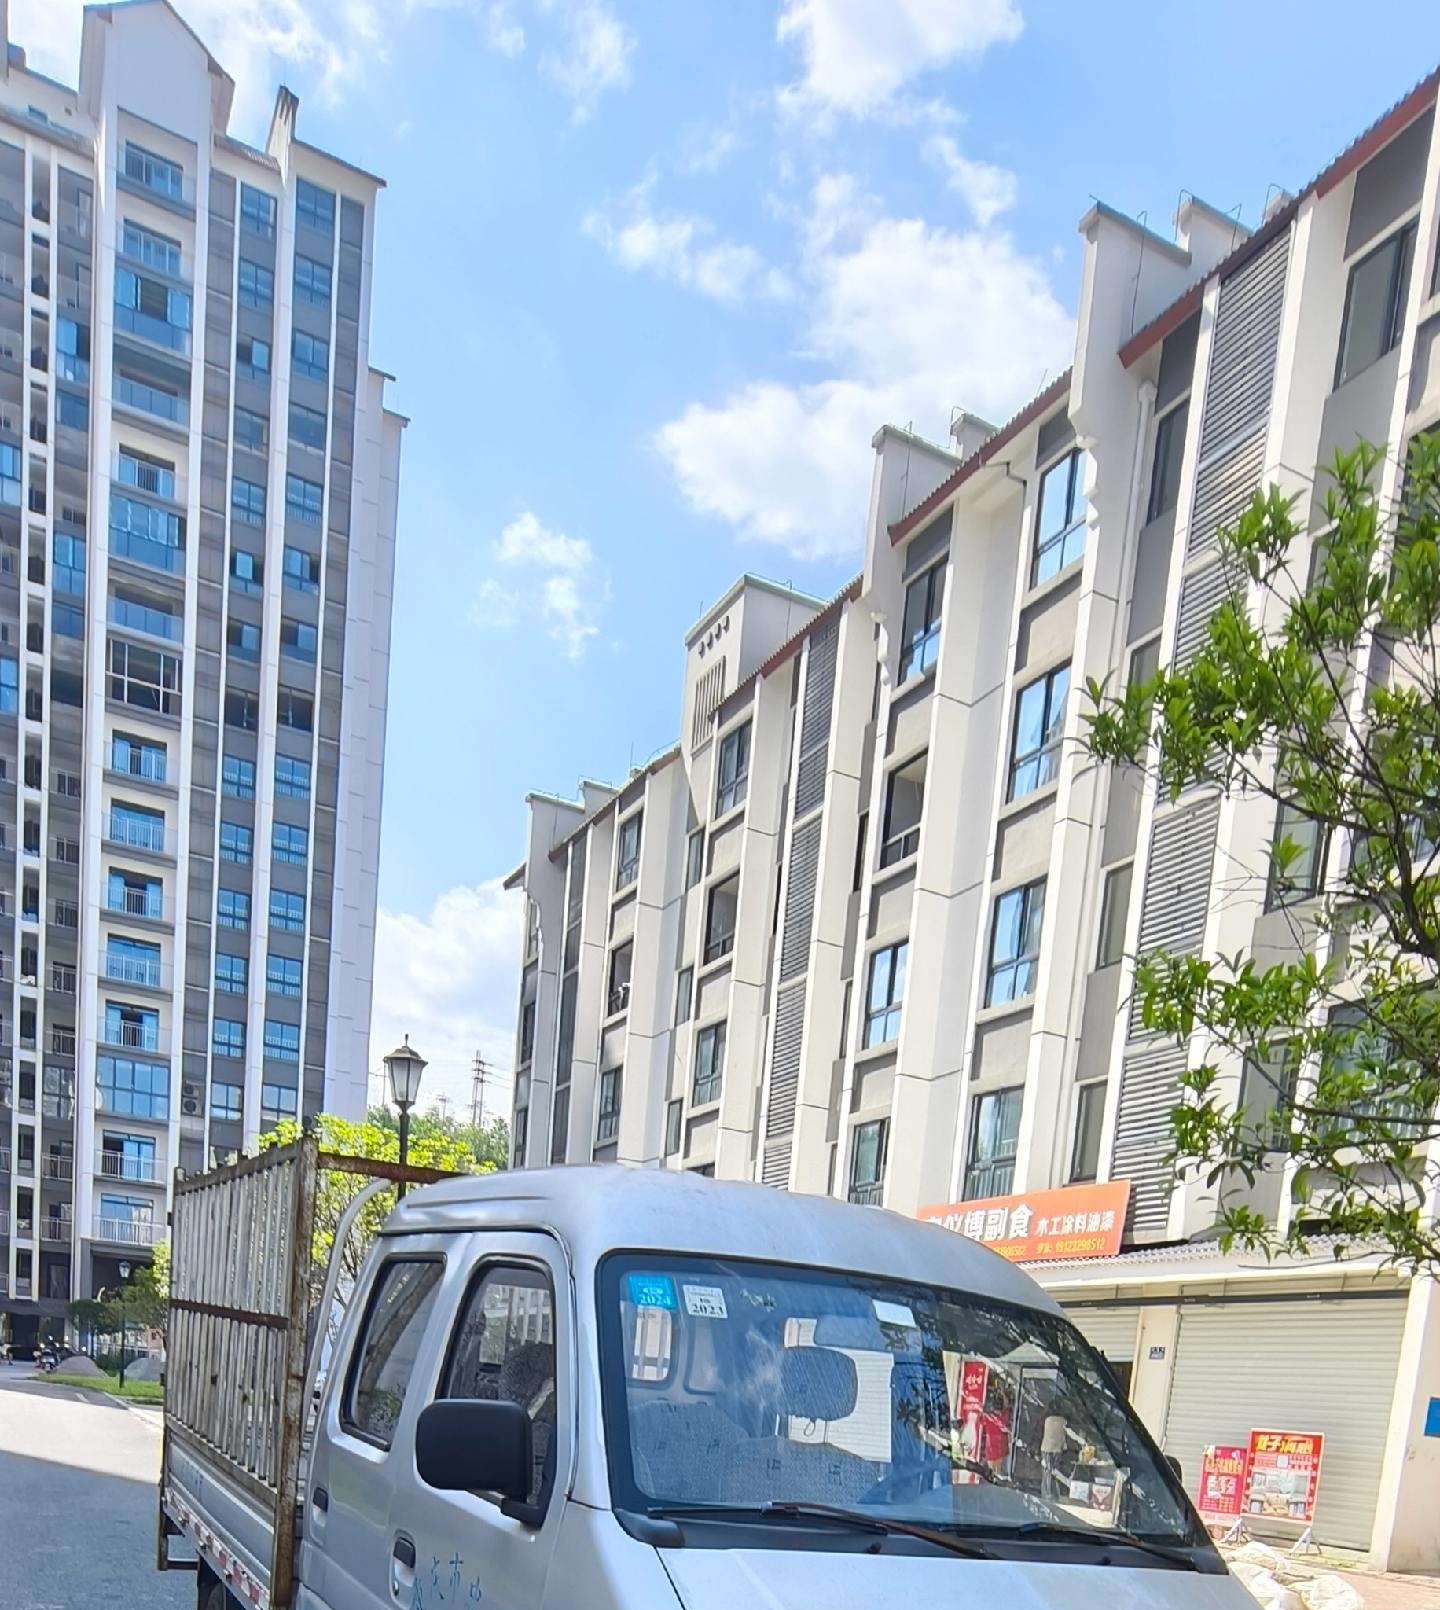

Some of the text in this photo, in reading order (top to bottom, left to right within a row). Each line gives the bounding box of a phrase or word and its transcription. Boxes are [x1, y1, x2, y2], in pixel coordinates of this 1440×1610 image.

[1036, 1210, 1115, 1237] 木工涂料油漆
[639, 1293, 672, 1306] 2024
[691, 1303, 725, 1315] 2023
